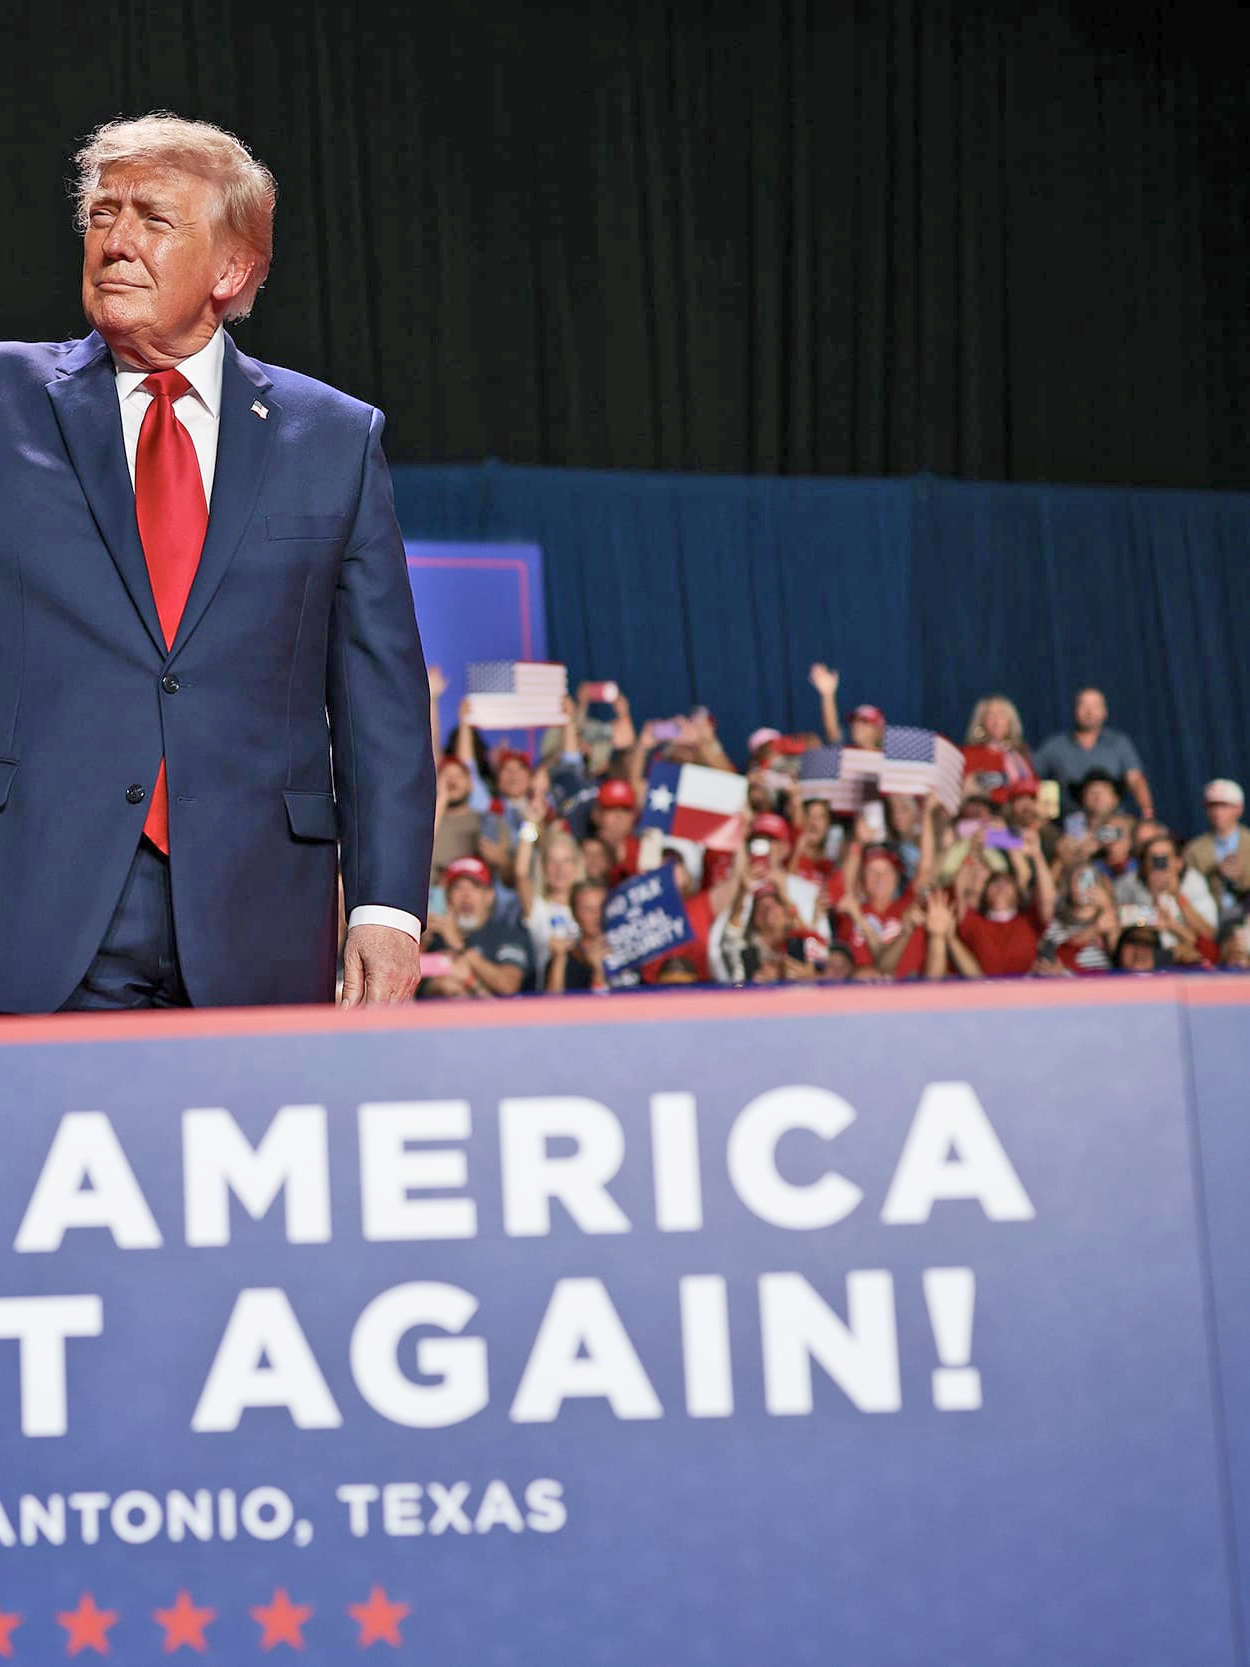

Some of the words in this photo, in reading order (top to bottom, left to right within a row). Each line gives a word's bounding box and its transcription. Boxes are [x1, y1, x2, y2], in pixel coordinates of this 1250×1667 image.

[14, 1080, 1036, 1253] AMERICA
[191, 1266, 982, 1432] AGAIN!
[336, 1478, 568, 1538] TEXAS
